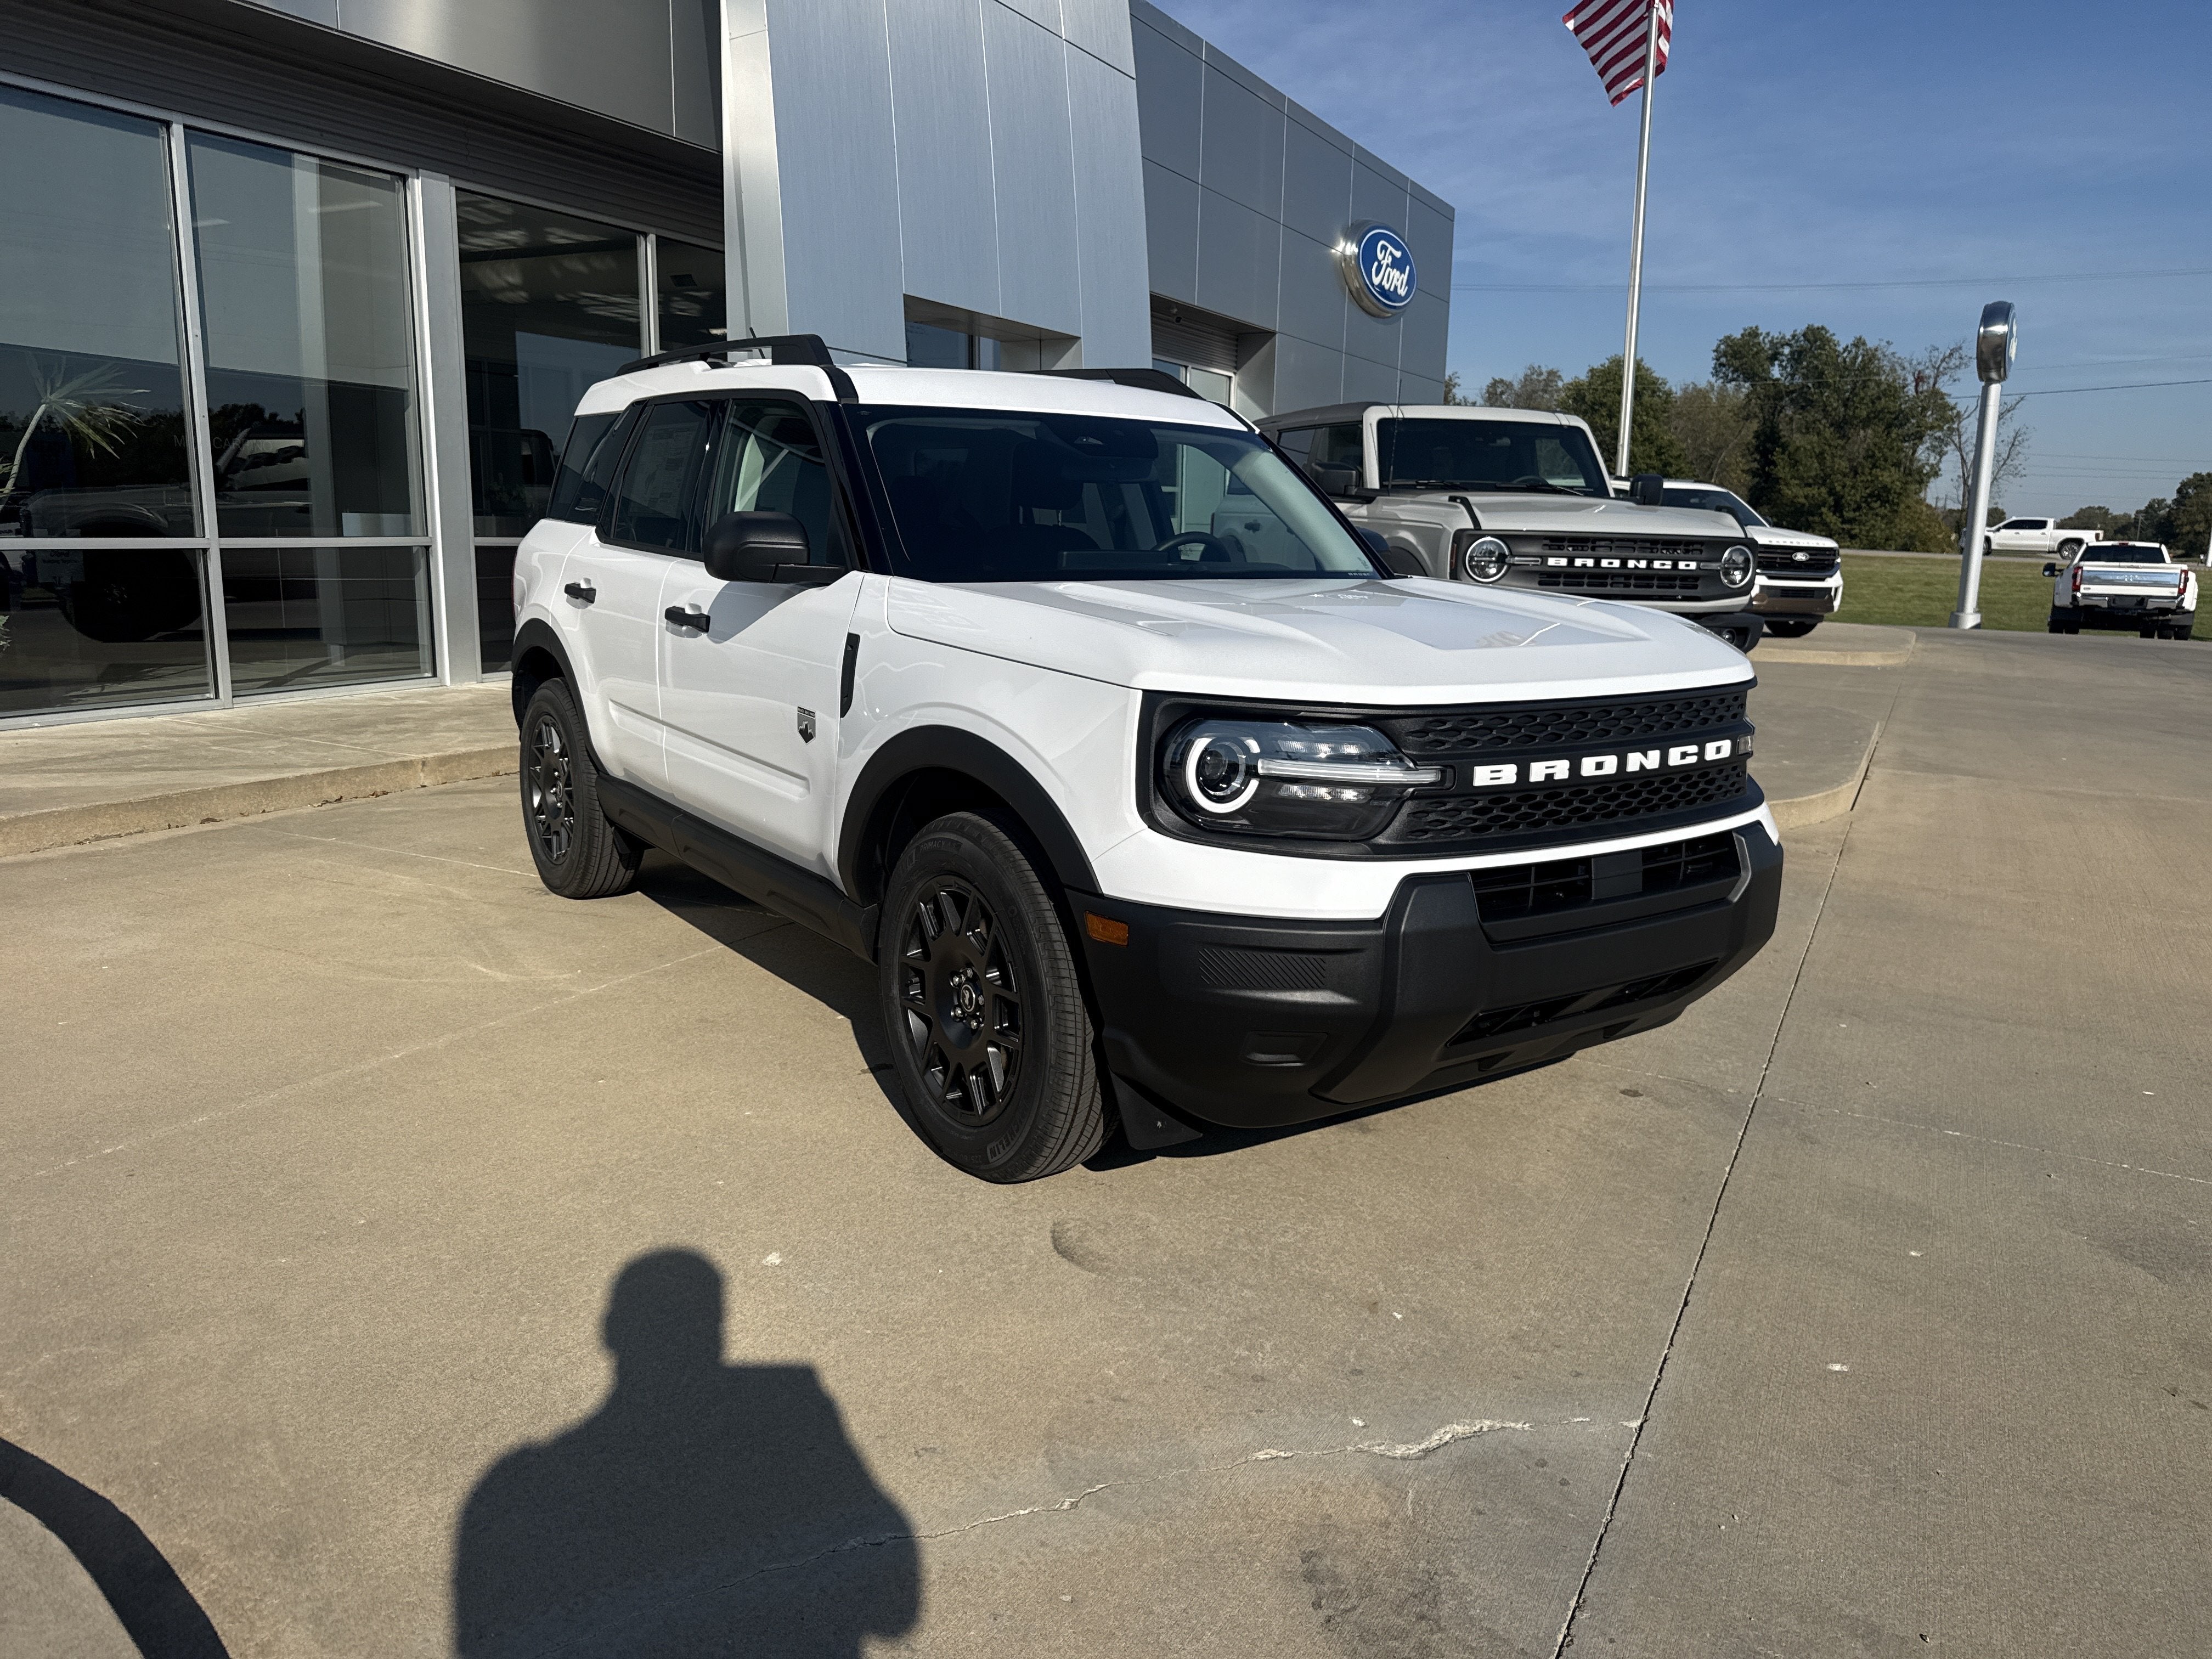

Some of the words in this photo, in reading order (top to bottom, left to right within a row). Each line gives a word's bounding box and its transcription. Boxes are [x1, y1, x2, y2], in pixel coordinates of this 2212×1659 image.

[1372, 240, 1409, 297] Ford
[1547, 556, 1698, 570] BRONCO
[1473, 740, 1731, 786] BRONCO
